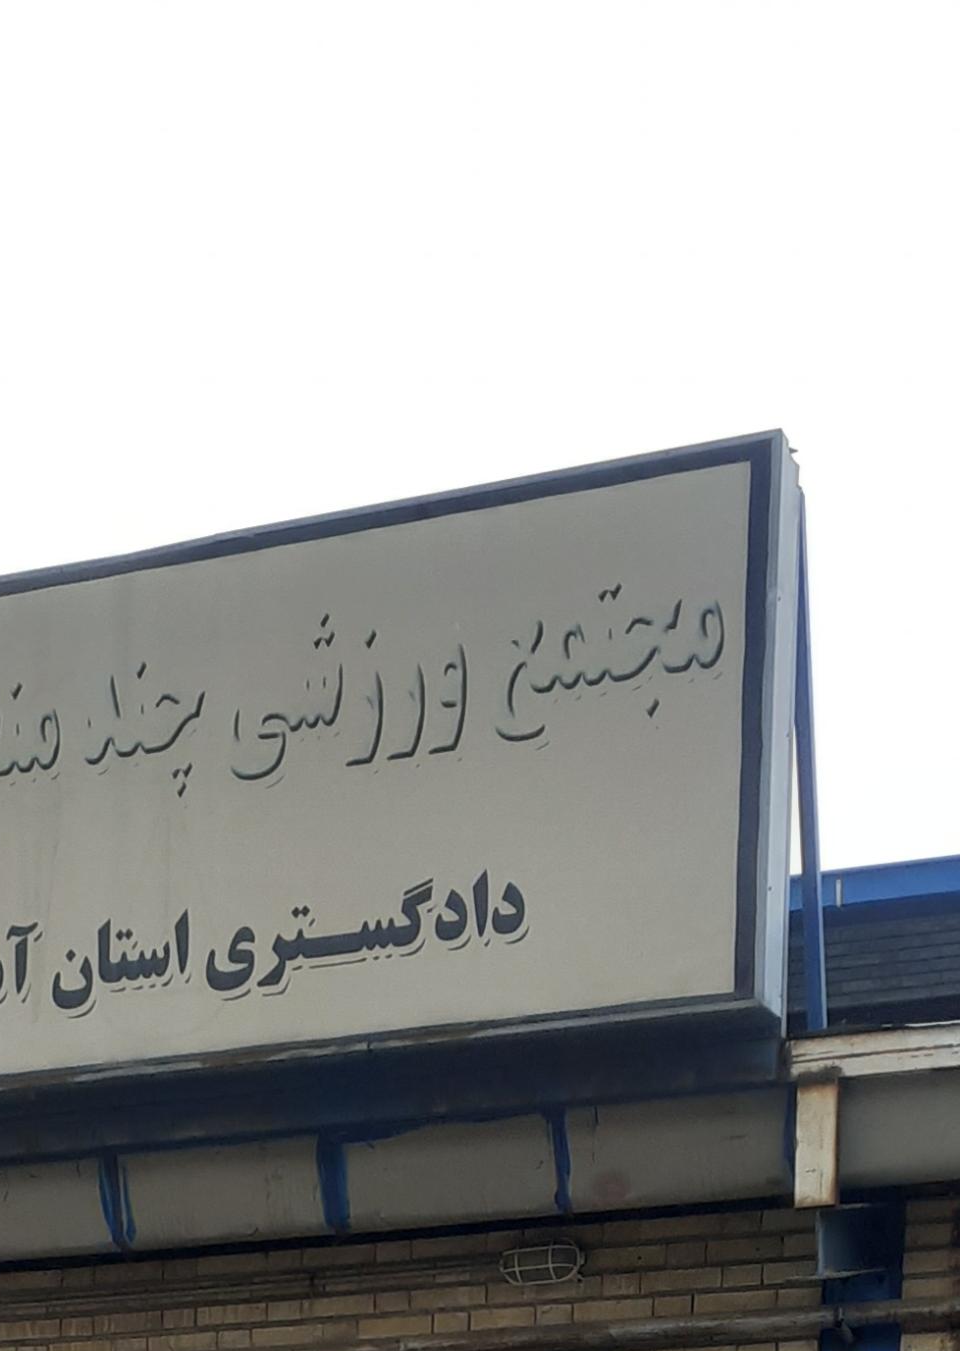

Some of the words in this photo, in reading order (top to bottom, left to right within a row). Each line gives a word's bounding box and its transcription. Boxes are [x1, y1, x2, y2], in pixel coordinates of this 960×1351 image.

[80, 660, 206, 800] چند
[230, 610, 468, 784] ورزشی
[495, 582, 726, 748] مجتمع
[48, 905, 190, 1015] استان
[205, 868, 530, 1002] دادگستری
